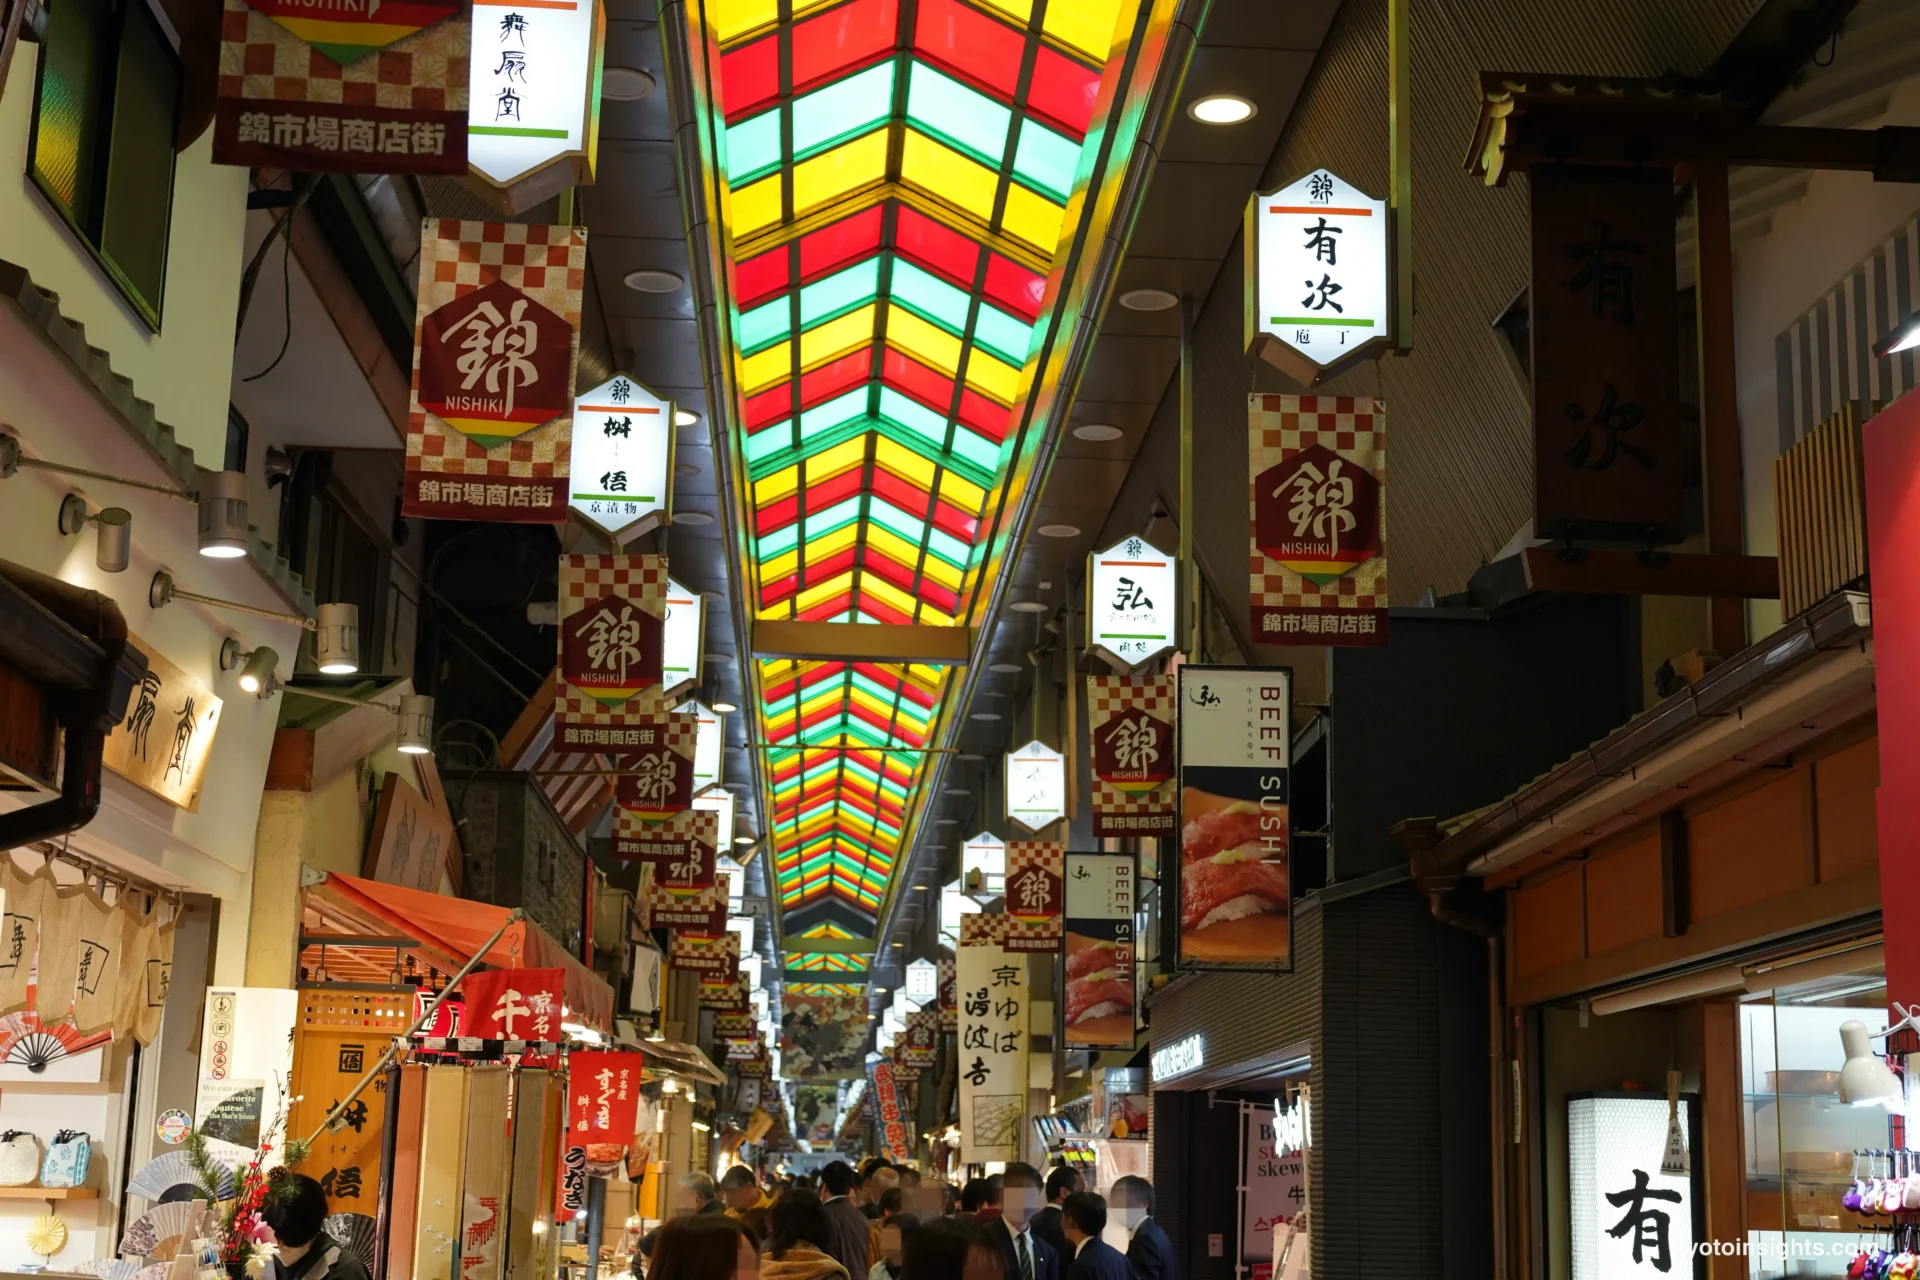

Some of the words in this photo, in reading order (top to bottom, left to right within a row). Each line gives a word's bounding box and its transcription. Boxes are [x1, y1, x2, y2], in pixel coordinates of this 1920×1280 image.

[493, 12, 530, 122] 舞扇堂
[238, 112, 445, 155] 錦市場商店街
[1305, 173, 1334, 205] 錦
[1301, 216, 1344, 314] 有次
[1294, 328, 1350, 345] 庖丁
[1561, 217, 1659, 473] 有次
[440, 298, 539, 419] 錦
[445, 395, 504, 413] NISHIKI
[608, 379, 630, 405] 錦
[418, 479, 554, 509] 錦市場商店街
[589, 500, 638, 515] 京漬物
[1272, 459, 1357, 560] 錦
[1124, 539, 1142, 560] 錦
[1281, 542, 1330, 555] NISHIKI
[1112, 576, 1154, 611] 弘
[1262, 613, 1377, 634] 錦市場商店街
[575, 605, 642, 687] 錦
[580, 672, 620, 683] NISHIKI
[564, 727, 655, 746] 錦市場商店街
[1260, 686, 1281, 760] BEEF
[1104, 715, 1159, 781] 錦
[629, 750, 677, 811] 錦
[1111, 770, 1143, 780] NISHIKI
[631, 799, 660, 809] NISHIKI
[1101, 815, 1173, 829] 錦市場商店街
[1260, 775, 1281, 864] SUSHI
[617, 841, 685, 856] 錦市場商店街
[1014, 870, 1052, 916] 錦
[1115, 866, 1130, 914] BEEF
[1115, 924, 1130, 982] SUSHI
[991, 965, 1023, 1054] 京ゆば
[375, 1045, 393, 1093] 京物
[616, 1069, 630, 1101] 京名産
[594, 1067, 616, 1130] すぐき
[1604, 1168, 1683, 1273] 有
